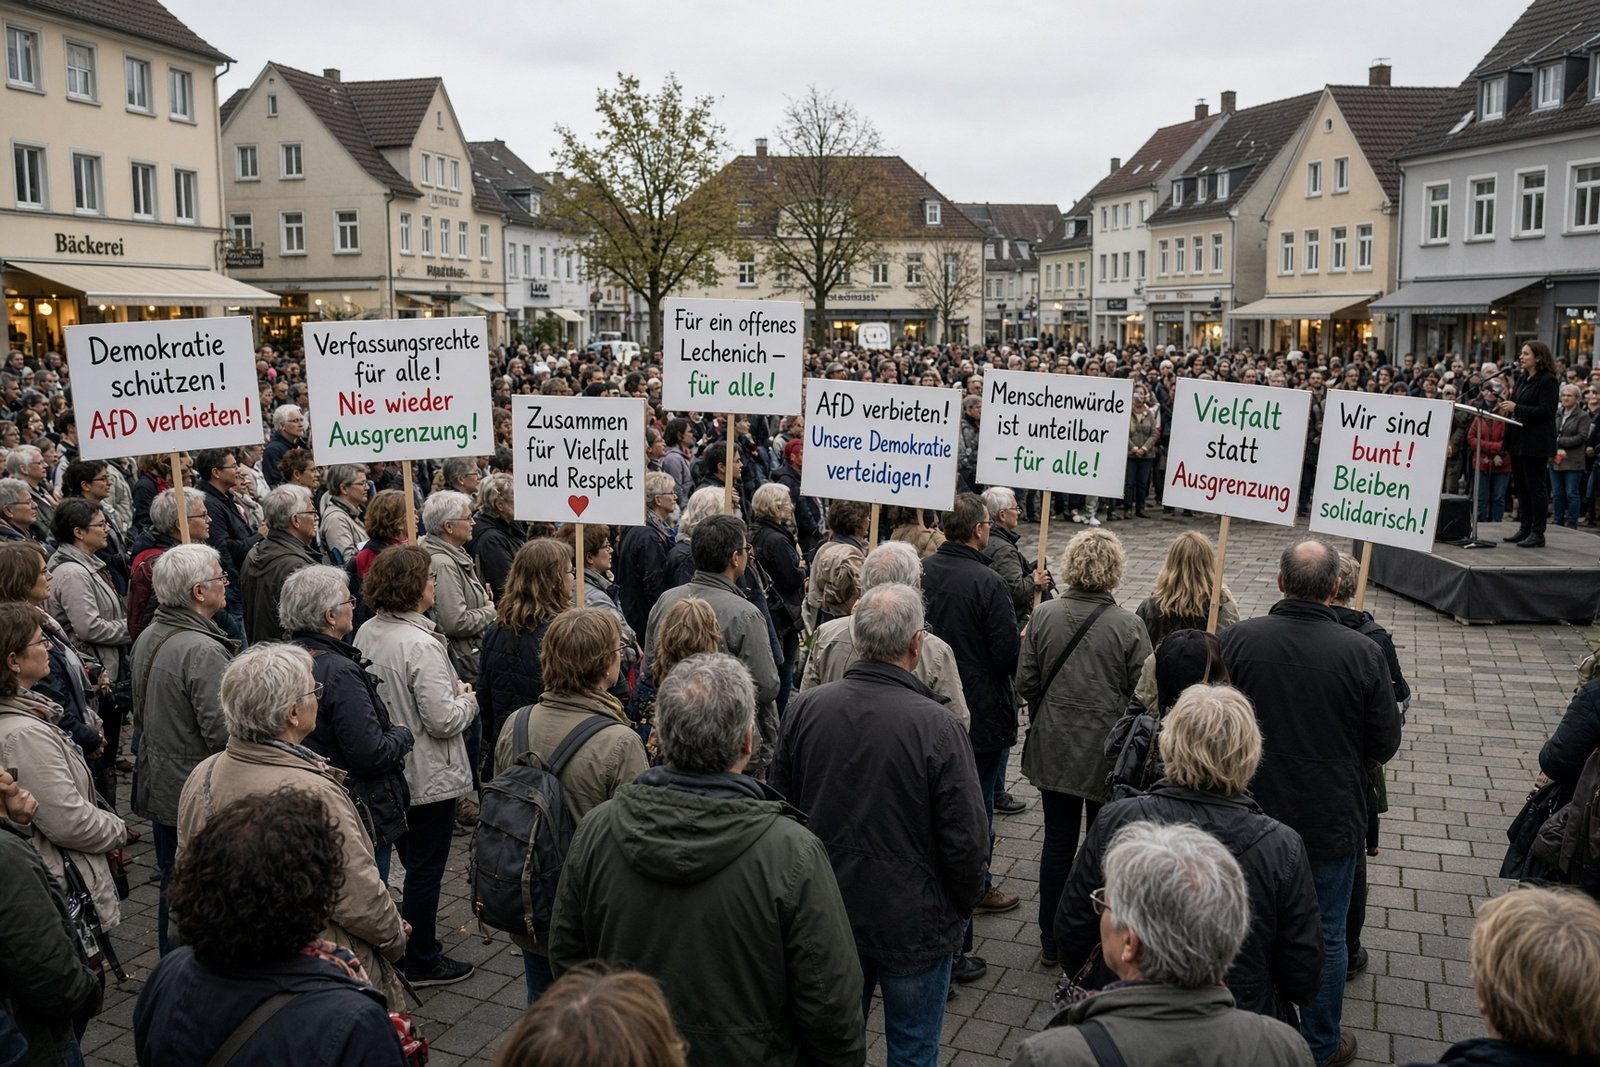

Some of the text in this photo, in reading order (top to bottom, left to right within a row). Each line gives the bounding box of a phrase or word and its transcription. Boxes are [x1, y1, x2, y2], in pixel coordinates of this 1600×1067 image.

[54, 232, 125, 256] Bäckerei
[674, 308, 797, 337] Für ein offenes
[87, 330, 225, 366] Demokratie
[312, 328, 480, 359] Verfassungsrechte
[680, 338, 767, 364] Lechenich
[111, 361, 226, 399] schützen!
[354, 356, 441, 389] für alle!
[687, 369, 775, 399] für alle!
[338, 387, 454, 417] Nie wieder
[815, 390, 950, 425] AfD verbieten!
[990, 380, 1125, 414] Menschenwürde
[1193, 392, 1283, 432] Vielfalt
[89, 396, 251, 440] AfD verbieten!
[328, 412, 477, 454] Ausgrenzung!
[526, 405, 628, 431] Zusammen
[997, 413, 1110, 444] ist unteilbar
[1340, 401, 1433, 438] Wir sind
[526, 435, 630, 465] für Vielfalt
[811, 424, 952, 458] Unsere Demokratie
[1205, 433, 1259, 464] statt
[1351, 434, 1415, 469] bunt!
[826, 459, 932, 495] verteidigen!
[1013, 445, 1045, 474] für
[1052, 449, 1100, 479] alle!
[526, 465, 634, 497] und Respekt
[1171, 460, 1291, 513] Ausgrenzung
[1333, 462, 1411, 501] Bleiben
[1319, 497, 1429, 535] solidarisch!
